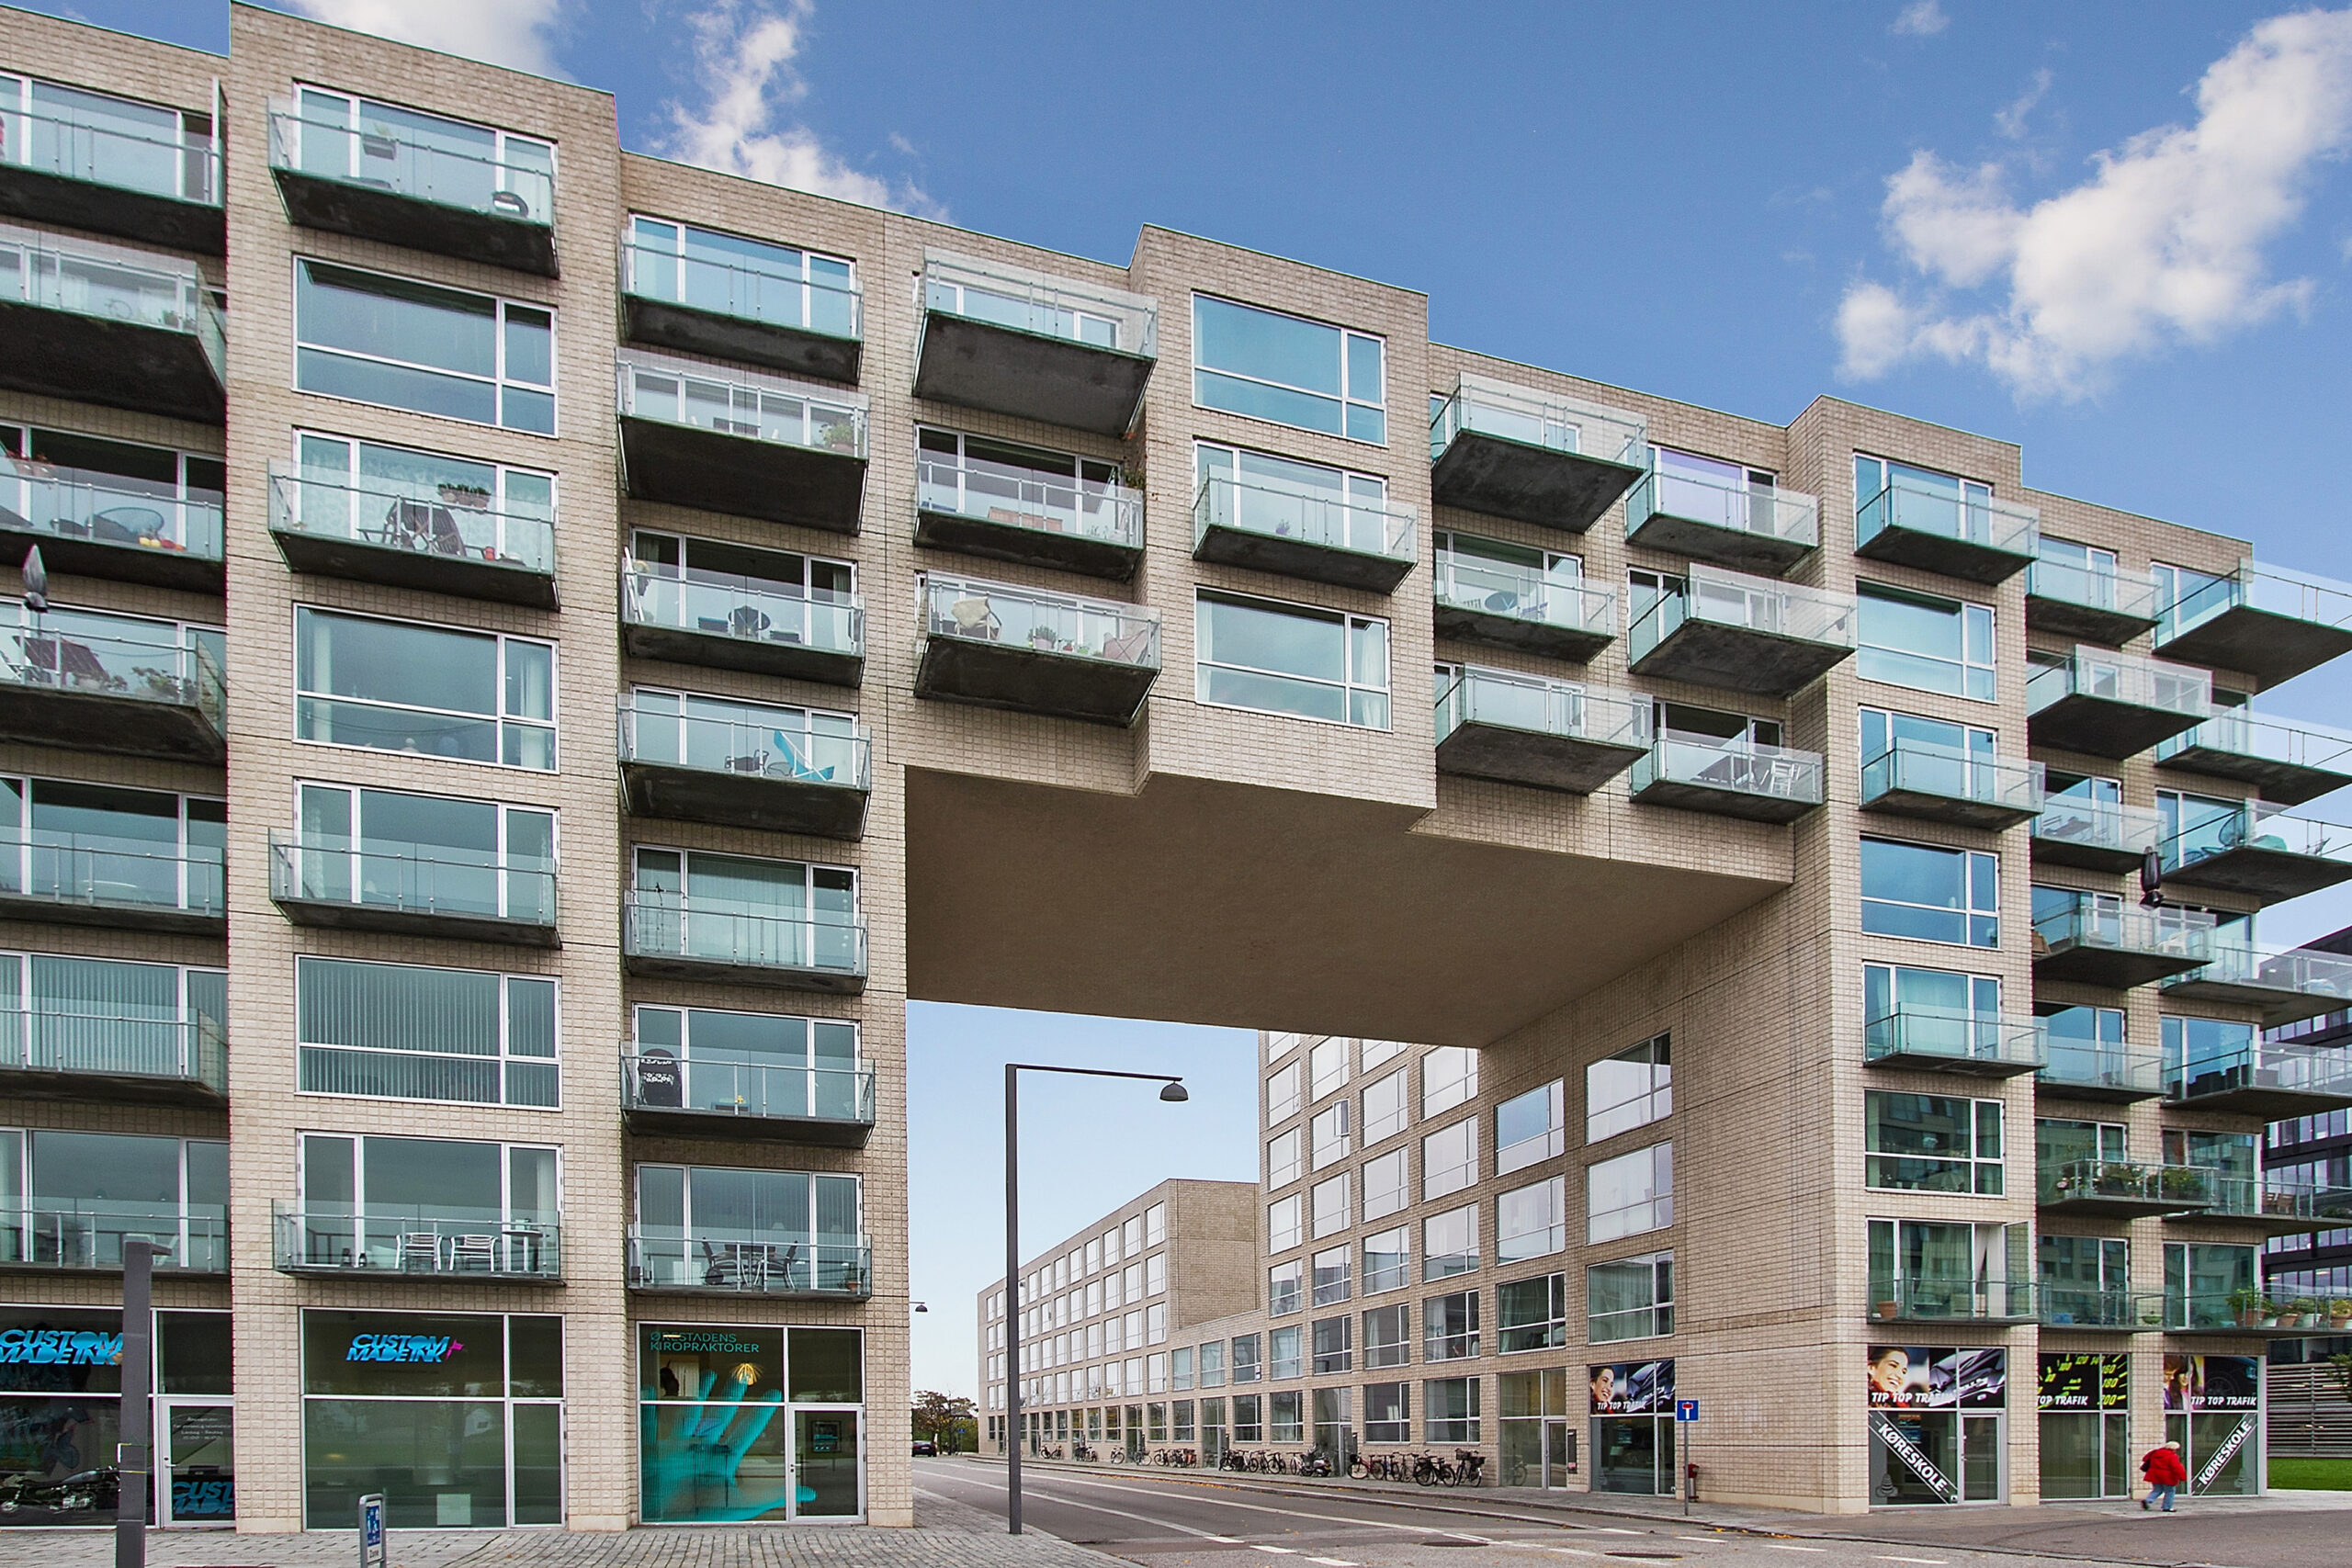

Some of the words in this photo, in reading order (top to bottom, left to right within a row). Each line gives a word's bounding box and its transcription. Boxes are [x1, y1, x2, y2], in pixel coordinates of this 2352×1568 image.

[0, 1329, 124, 1349] CUSTOM
[352, 1334, 450, 1349] CUSTOM
[650, 1341, 760, 1353] KIROPRAKTORER
[345, 1348, 410, 1361] MADE
[1871, 1393, 1890, 1404] TIP
[1893, 1392, 1913, 1404] TOP
[2055, 1395, 2089, 1405] TRAFIK
[2191, 1396, 2205, 1405] TIP
[2208, 1396, 2224, 1405] TOP
[2227, 1396, 2257, 1406] TRAFIK
[1598, 1402, 1608, 1410] TIP
[1610, 1402, 1622, 1410] TOP
[1878, 1423, 1948, 1492] KØRESKOLE
[2198, 1420, 2252, 1485] KØRESKOLE
